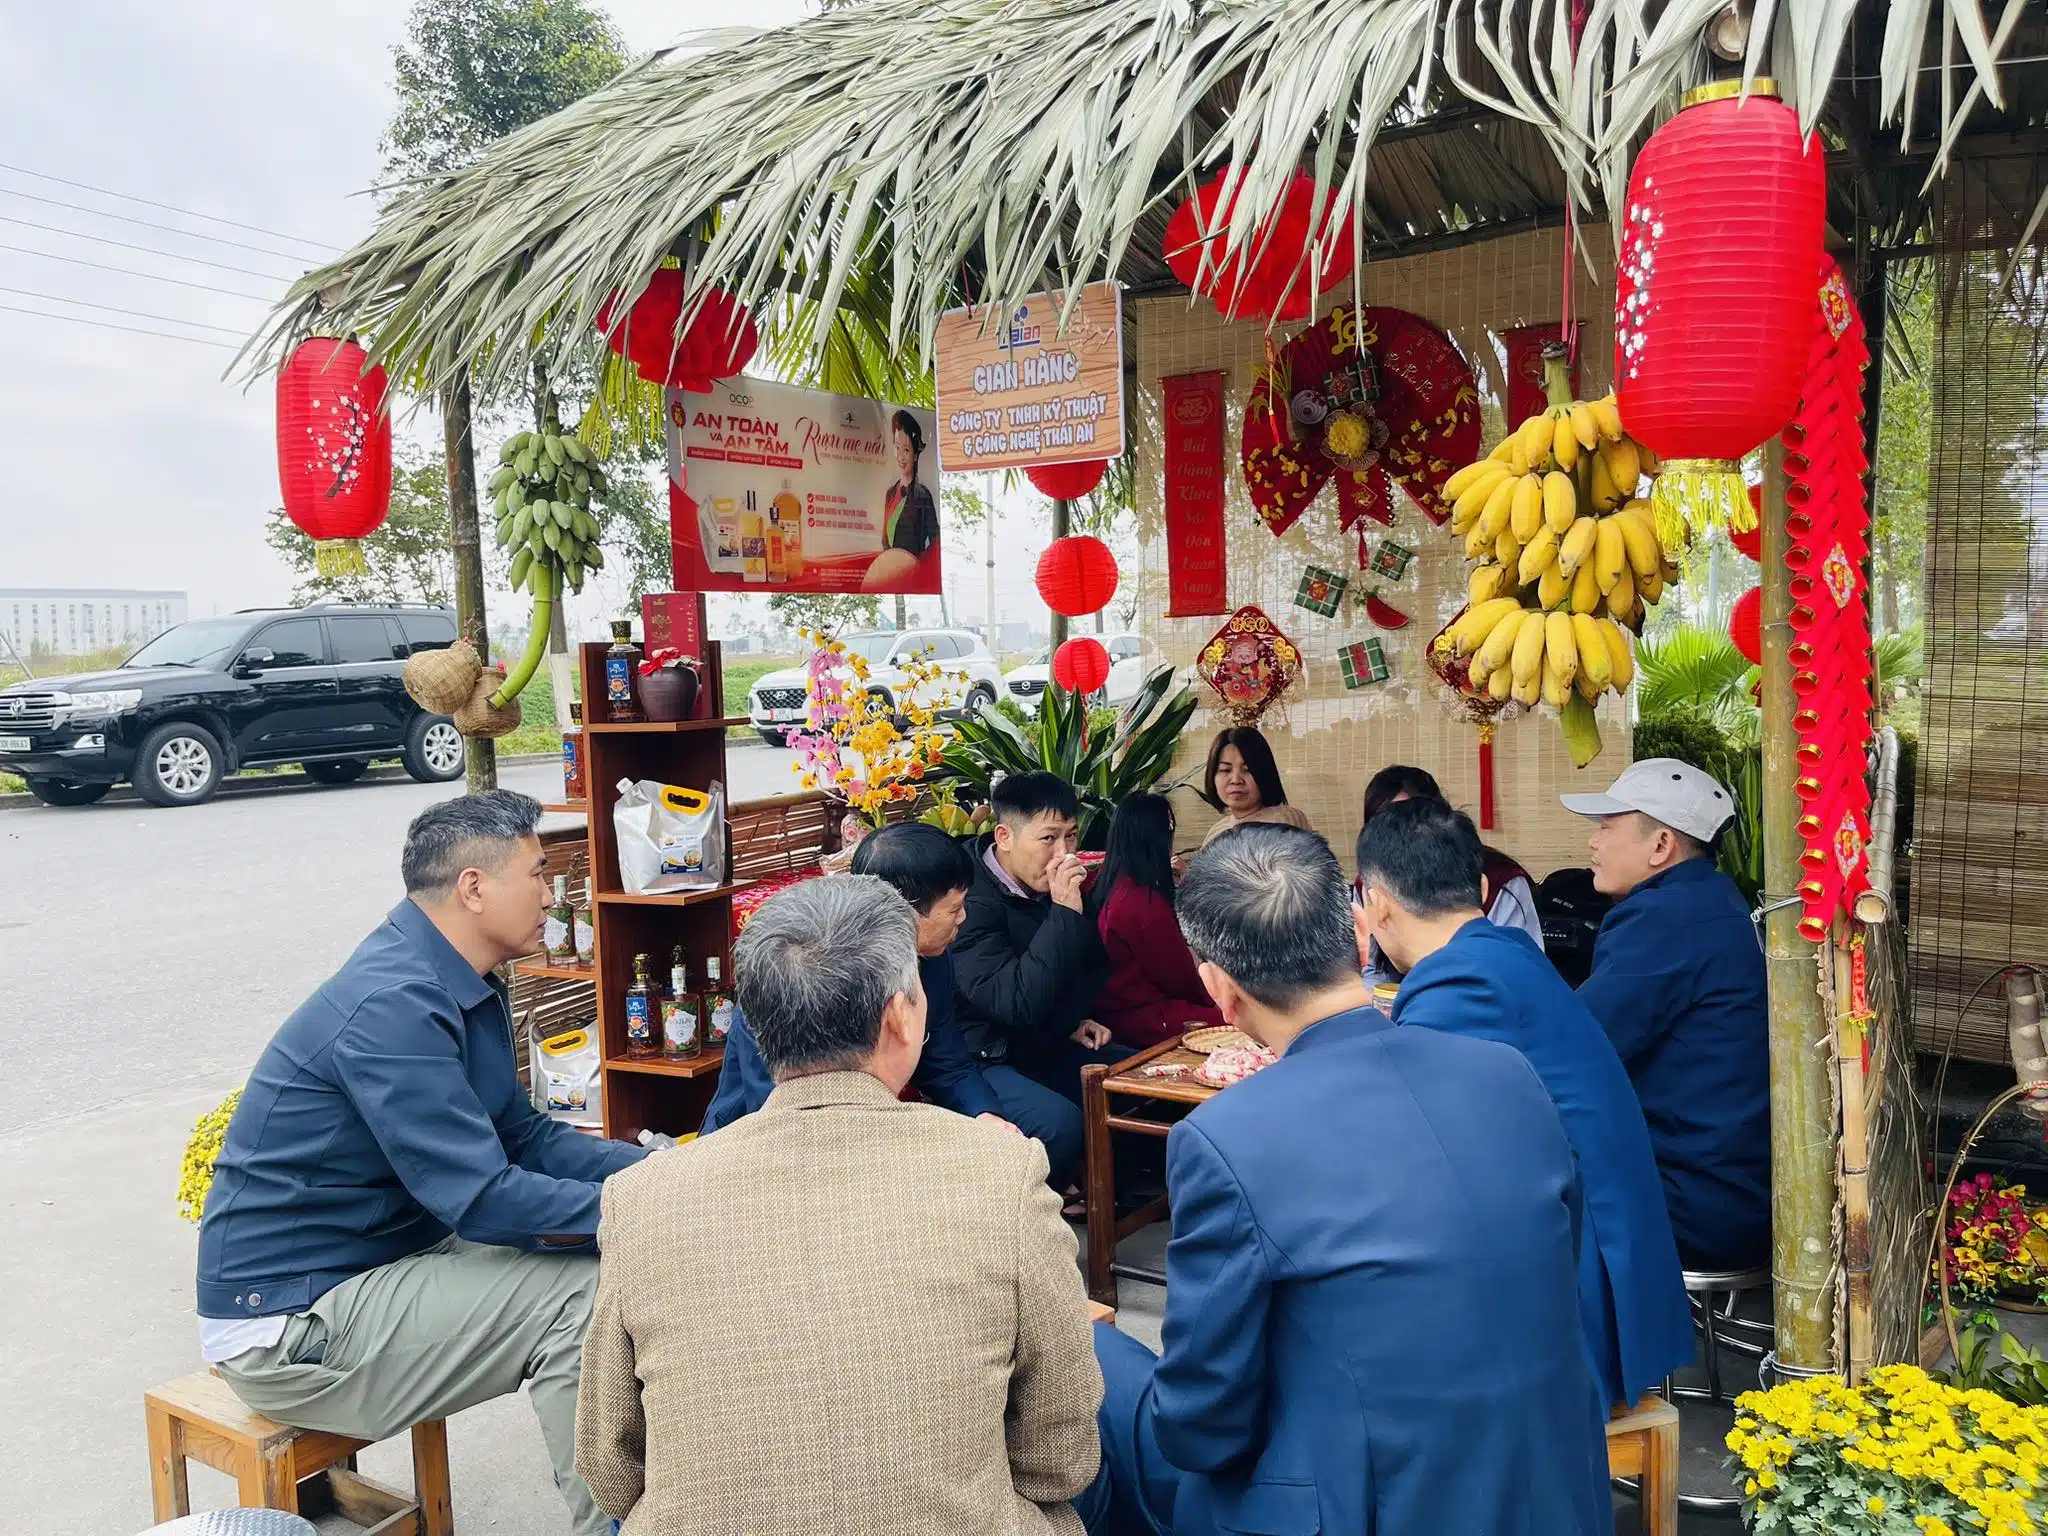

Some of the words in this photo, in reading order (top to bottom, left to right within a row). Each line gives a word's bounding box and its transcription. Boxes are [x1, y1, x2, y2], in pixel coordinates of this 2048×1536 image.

[974, 361, 1018, 394] GIAN
[1025, 350, 1077, 387] HÀNG
[692, 412, 722, 429] AN
[727, 416, 778, 437] TOÀN
[951, 410, 982, 432] CÔNG
[984, 409, 1001, 428] TY
[1008, 405, 1040, 425] TNHH
[1065, 392, 1107, 420] THUẬT
[724, 434, 751, 450] AN
[754, 436, 789, 456] TÂM
[964, 438, 972, 456] &
[975, 433, 1006, 455] CÔNG
[1010, 427, 1041, 454] NGHỆ
[1044, 422, 1072, 446] THÁI
[1077, 423, 1094, 443] AN
